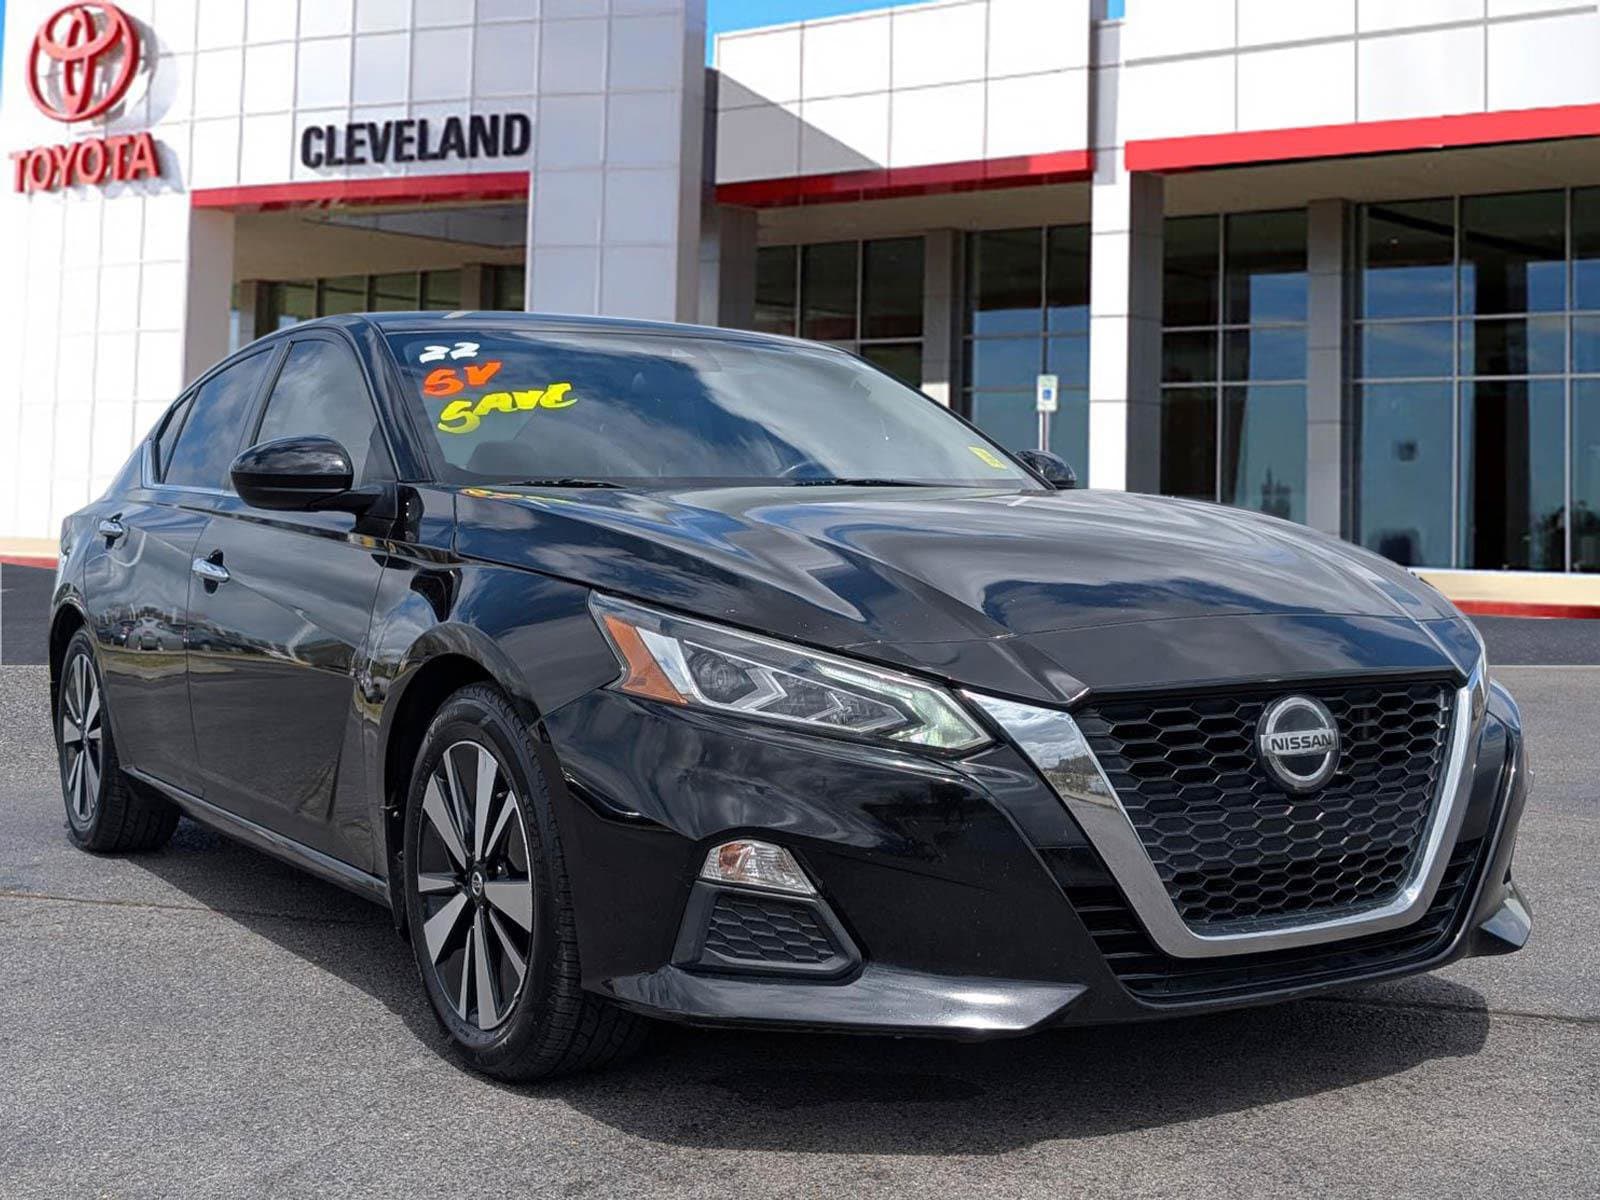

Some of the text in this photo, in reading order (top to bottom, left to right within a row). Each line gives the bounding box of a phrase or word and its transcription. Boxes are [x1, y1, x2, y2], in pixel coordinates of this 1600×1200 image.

[9, 132, 161, 194] TOYOTA
[301, 113, 531, 170] CLEVELAND
[419, 342, 481, 364] 22
[423, 360, 502, 396] SV
[437, 382, 578, 434] SAVE
[1271, 734, 1332, 751] NISSAN
